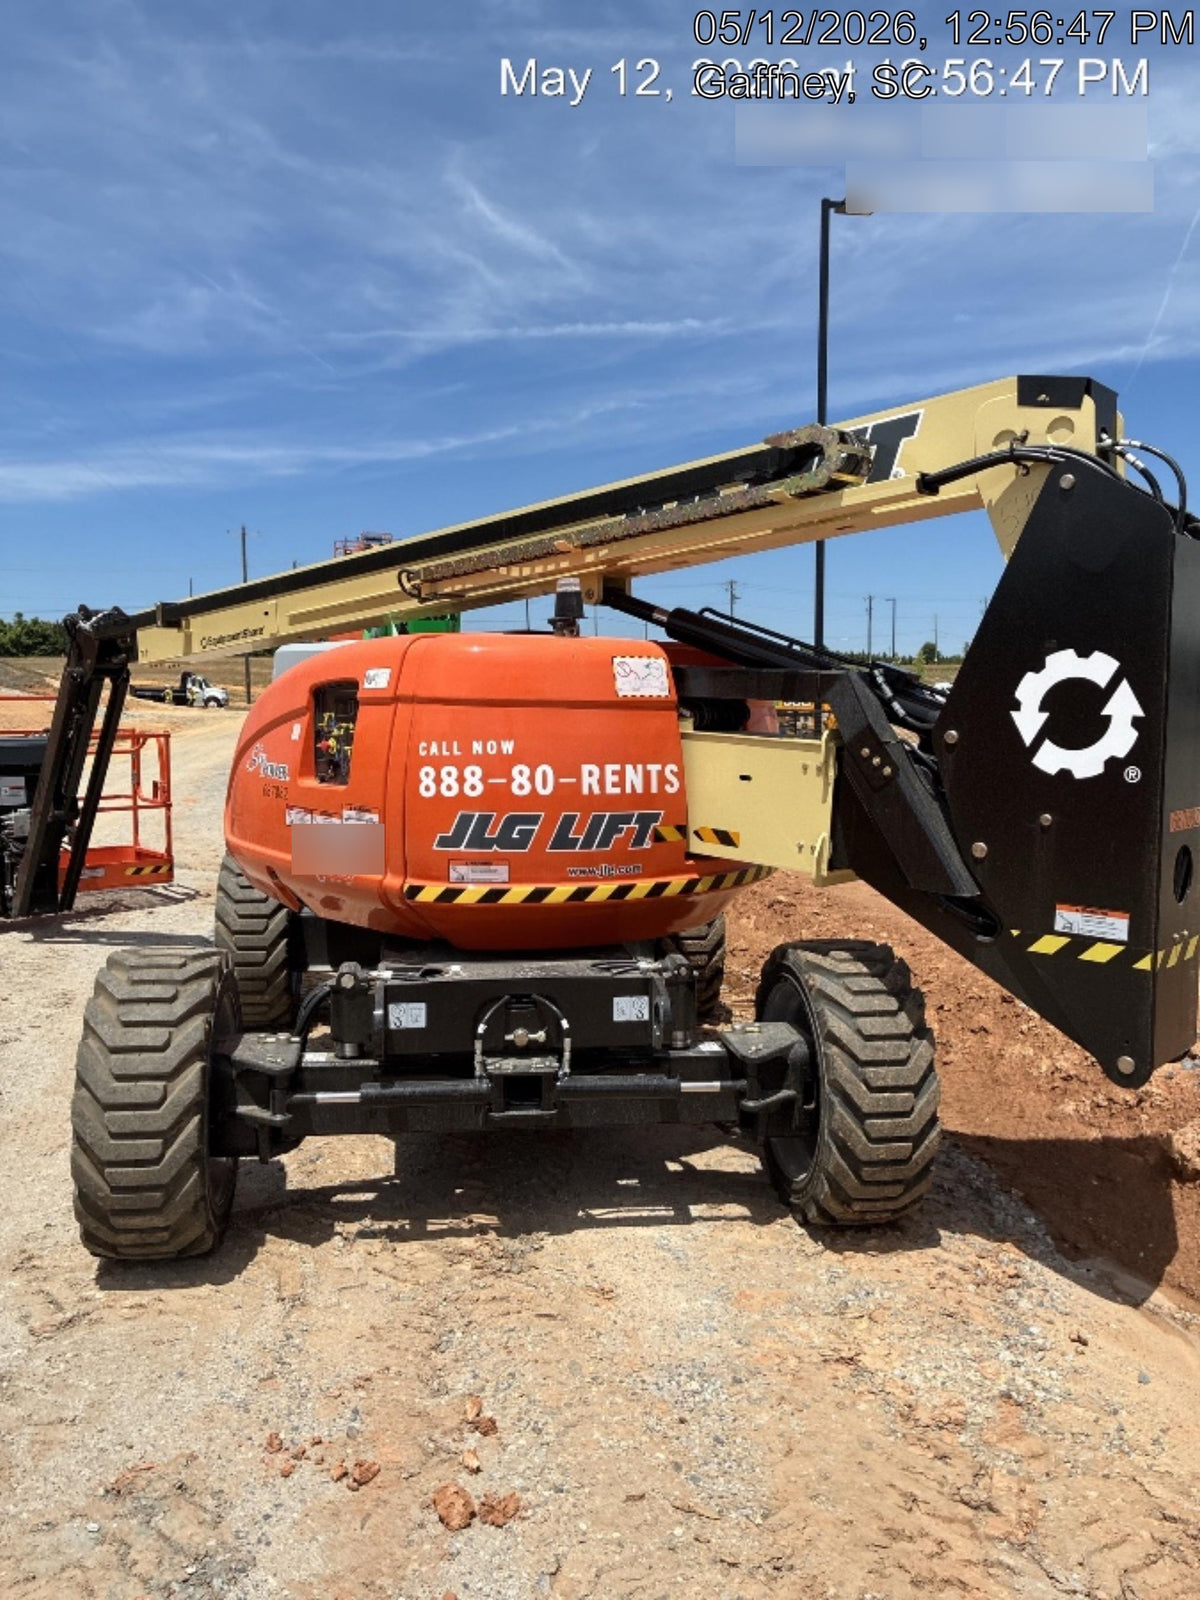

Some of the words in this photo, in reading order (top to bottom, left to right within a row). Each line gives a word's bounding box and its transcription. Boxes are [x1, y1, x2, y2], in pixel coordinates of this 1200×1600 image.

[418, 741, 462, 757] CALL
[472, 740, 515, 755] NOW
[433, 811, 544, 852] JLG
[546, 810, 665, 852] LIFT
[567, 864, 642, 878] www.jlg.com
